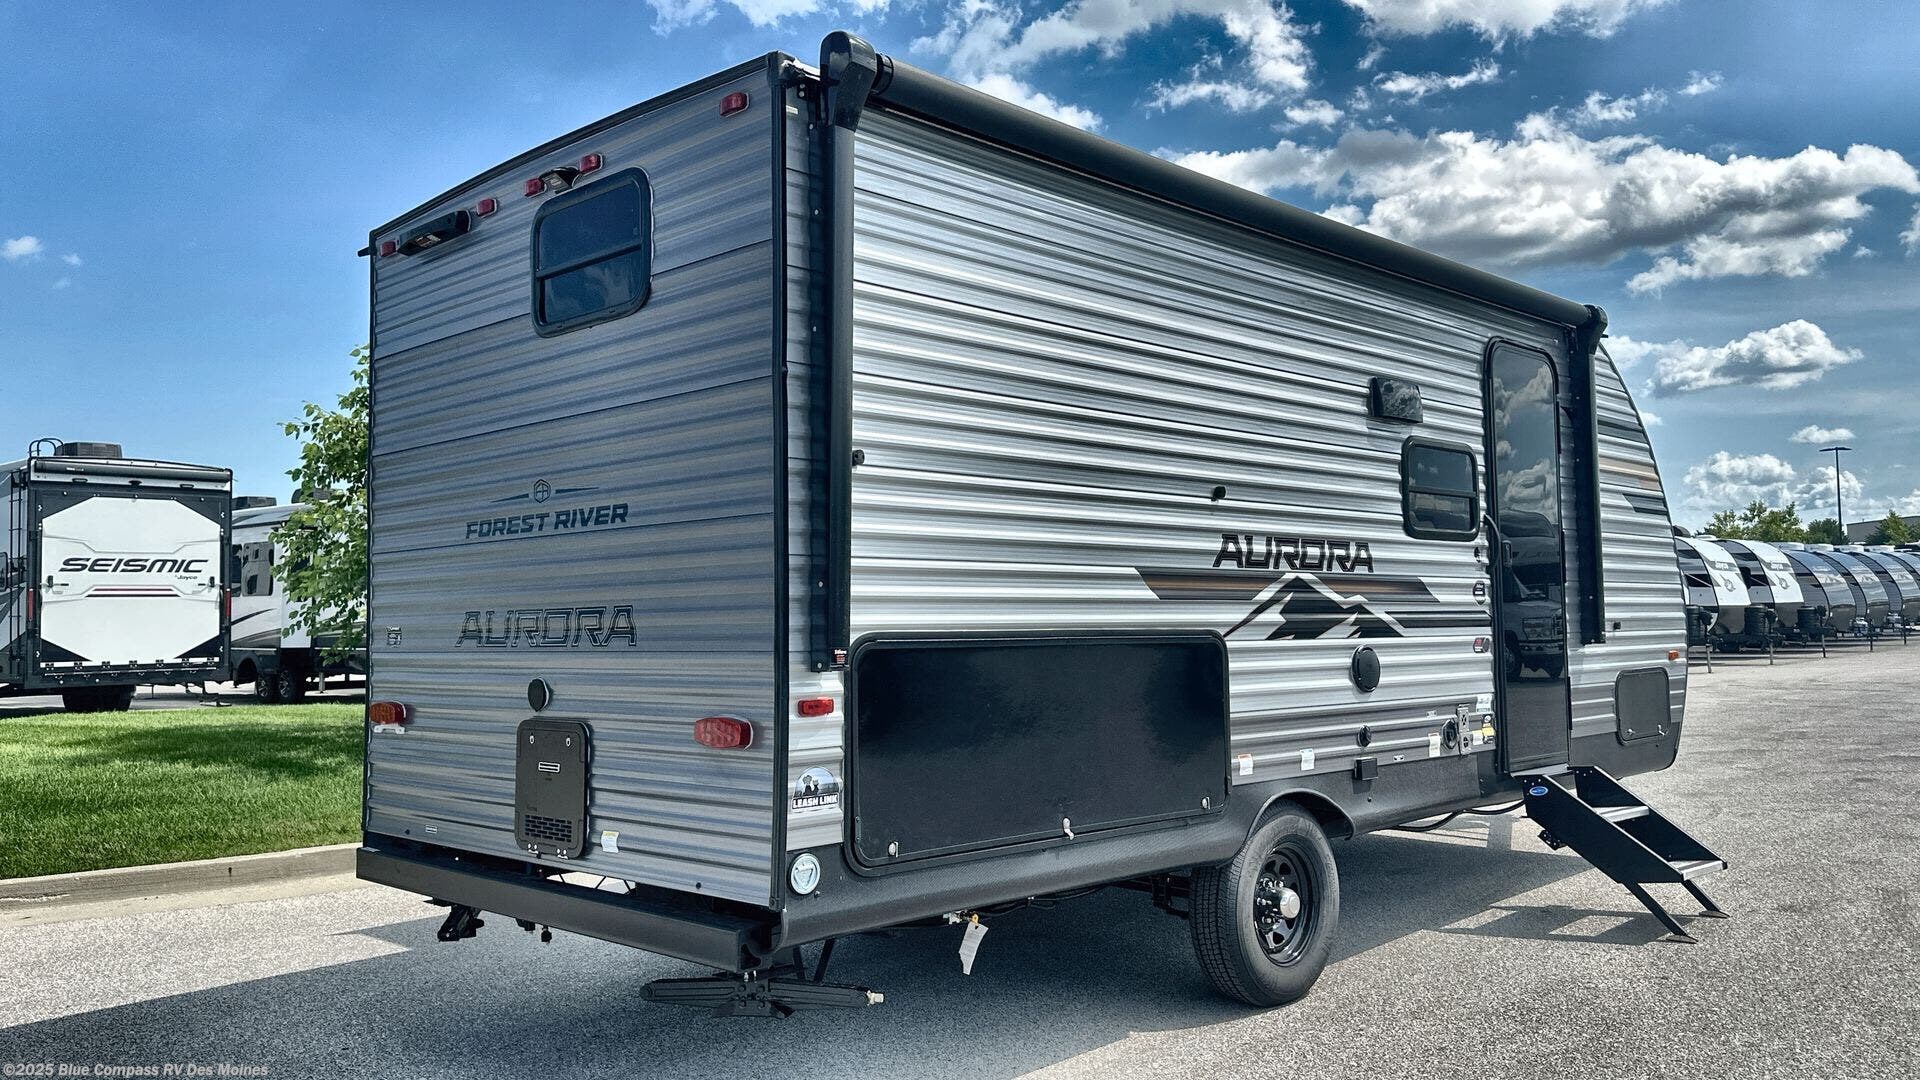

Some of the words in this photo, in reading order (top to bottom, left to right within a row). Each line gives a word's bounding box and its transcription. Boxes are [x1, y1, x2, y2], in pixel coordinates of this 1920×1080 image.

[465, 512, 550, 539] FOREST
[554, 503, 629, 530] RIVER
[58, 557, 209, 573] SEISMIC
[1212, 533, 1374, 573] AURORA
[455, 605, 638, 647] AURORA
[793, 798, 819, 808] LEASH
[820, 795, 838, 805] LINK
